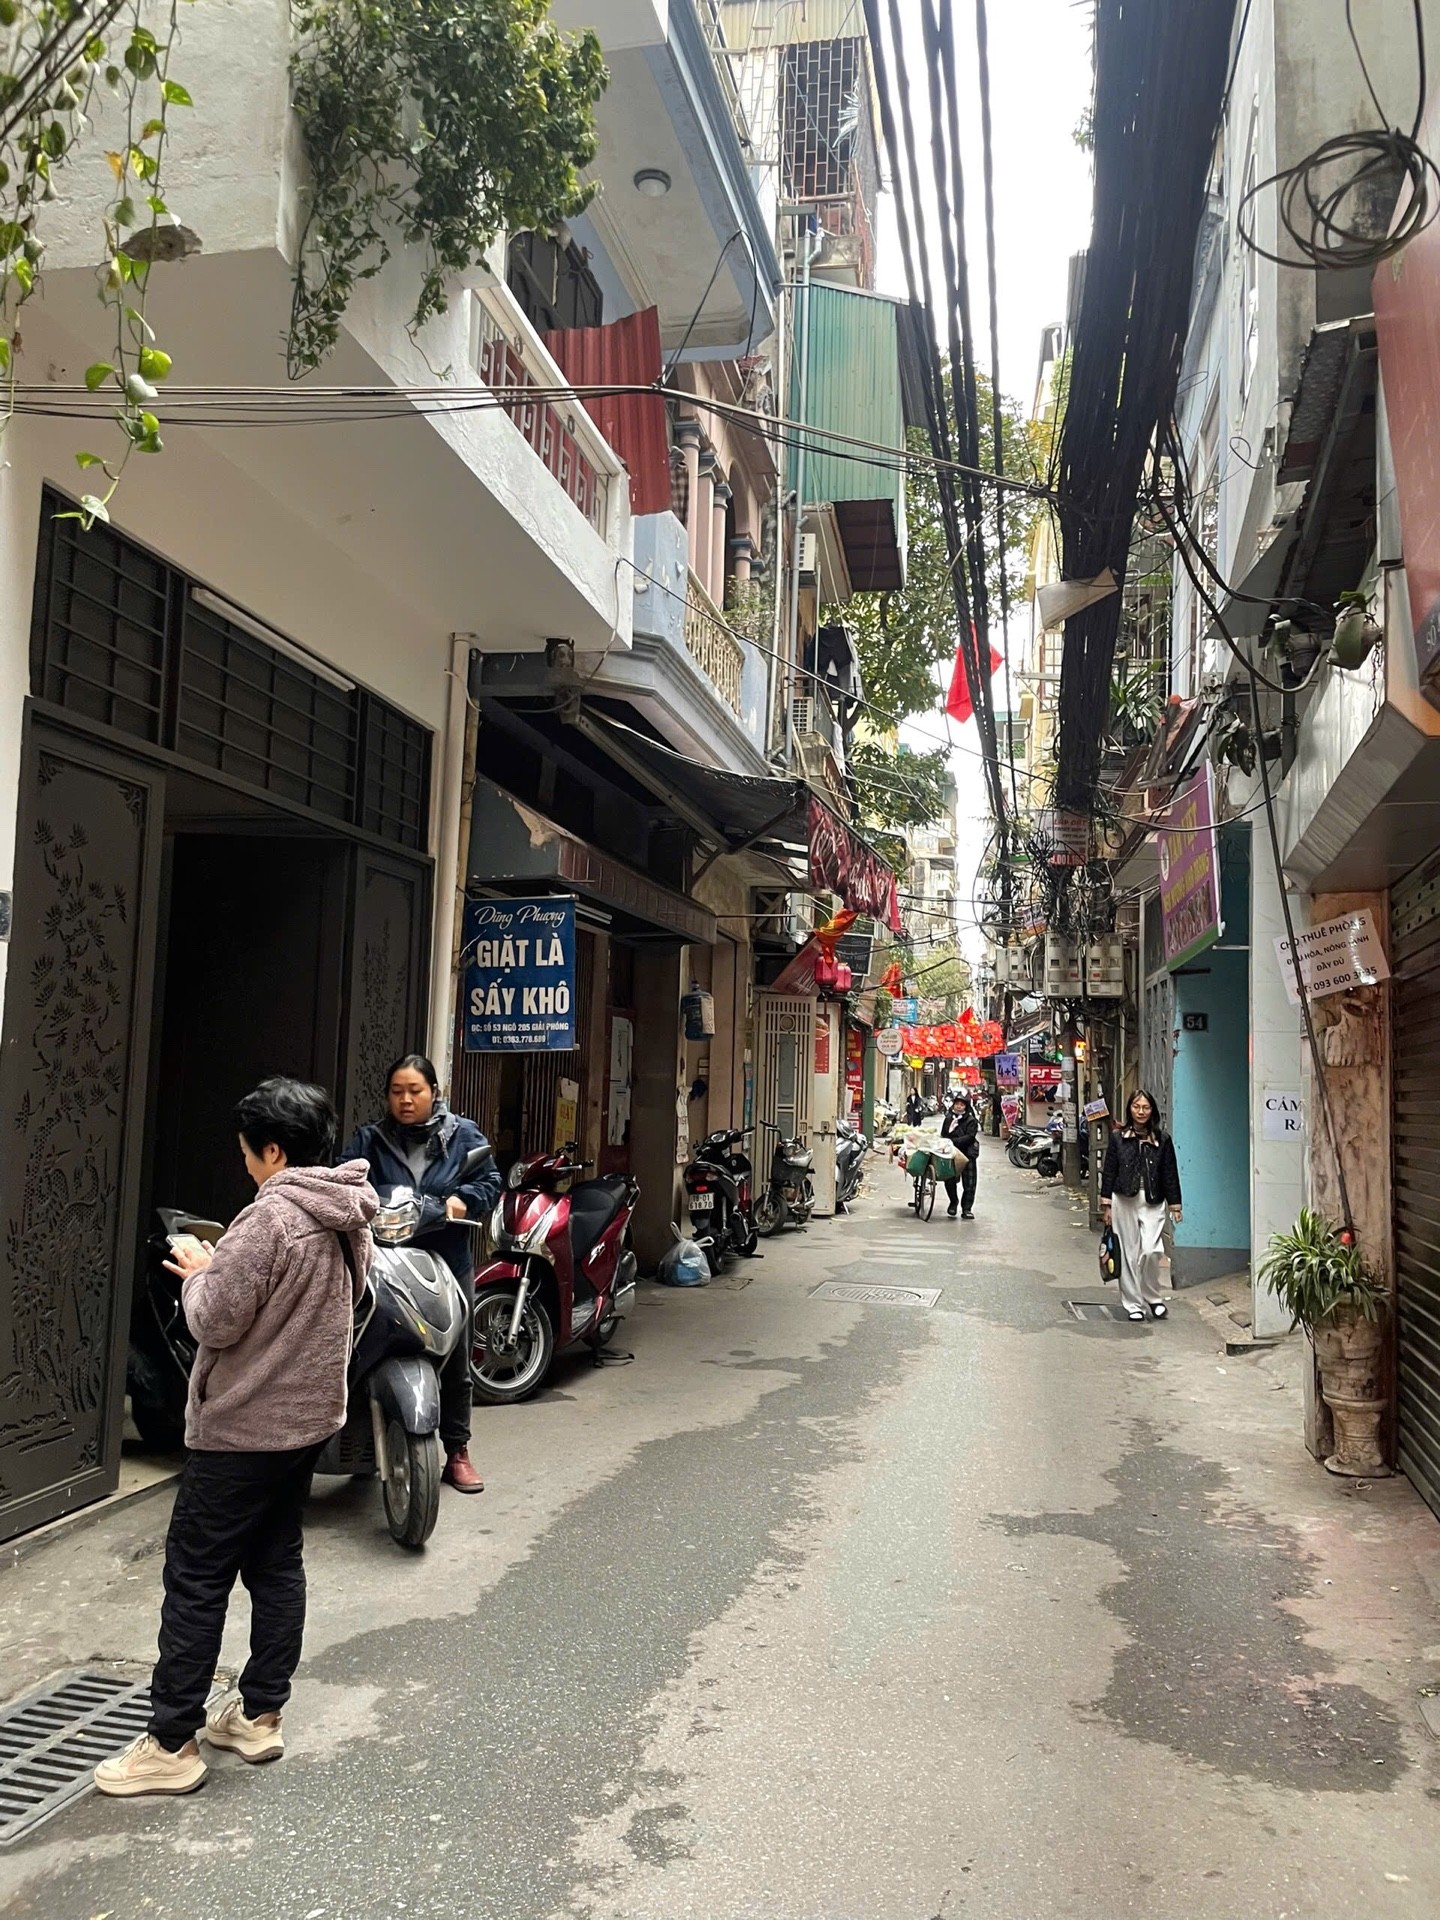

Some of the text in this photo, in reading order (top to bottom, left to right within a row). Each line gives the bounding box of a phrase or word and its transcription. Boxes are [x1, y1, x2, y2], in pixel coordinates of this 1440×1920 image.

[474, 904, 566, 930] Dũng Phượng
[1301, 926, 1328, 944] THUÊ
[476, 932, 565, 973] GIẶT LÀ
[1316, 956, 1345, 972] ĐẦY ĐỦ
[1313, 979, 1331, 991] 093
[1333, 973, 1351, 985] 600
[470, 978, 570, 1016] SẤY KHÔ
[492, 1023, 501, 1032] 53
[518, 1023, 531, 1032] 205
[1186, 1015, 1203, 1029] 54
[998, 1064, 1018, 1077] 4+5
